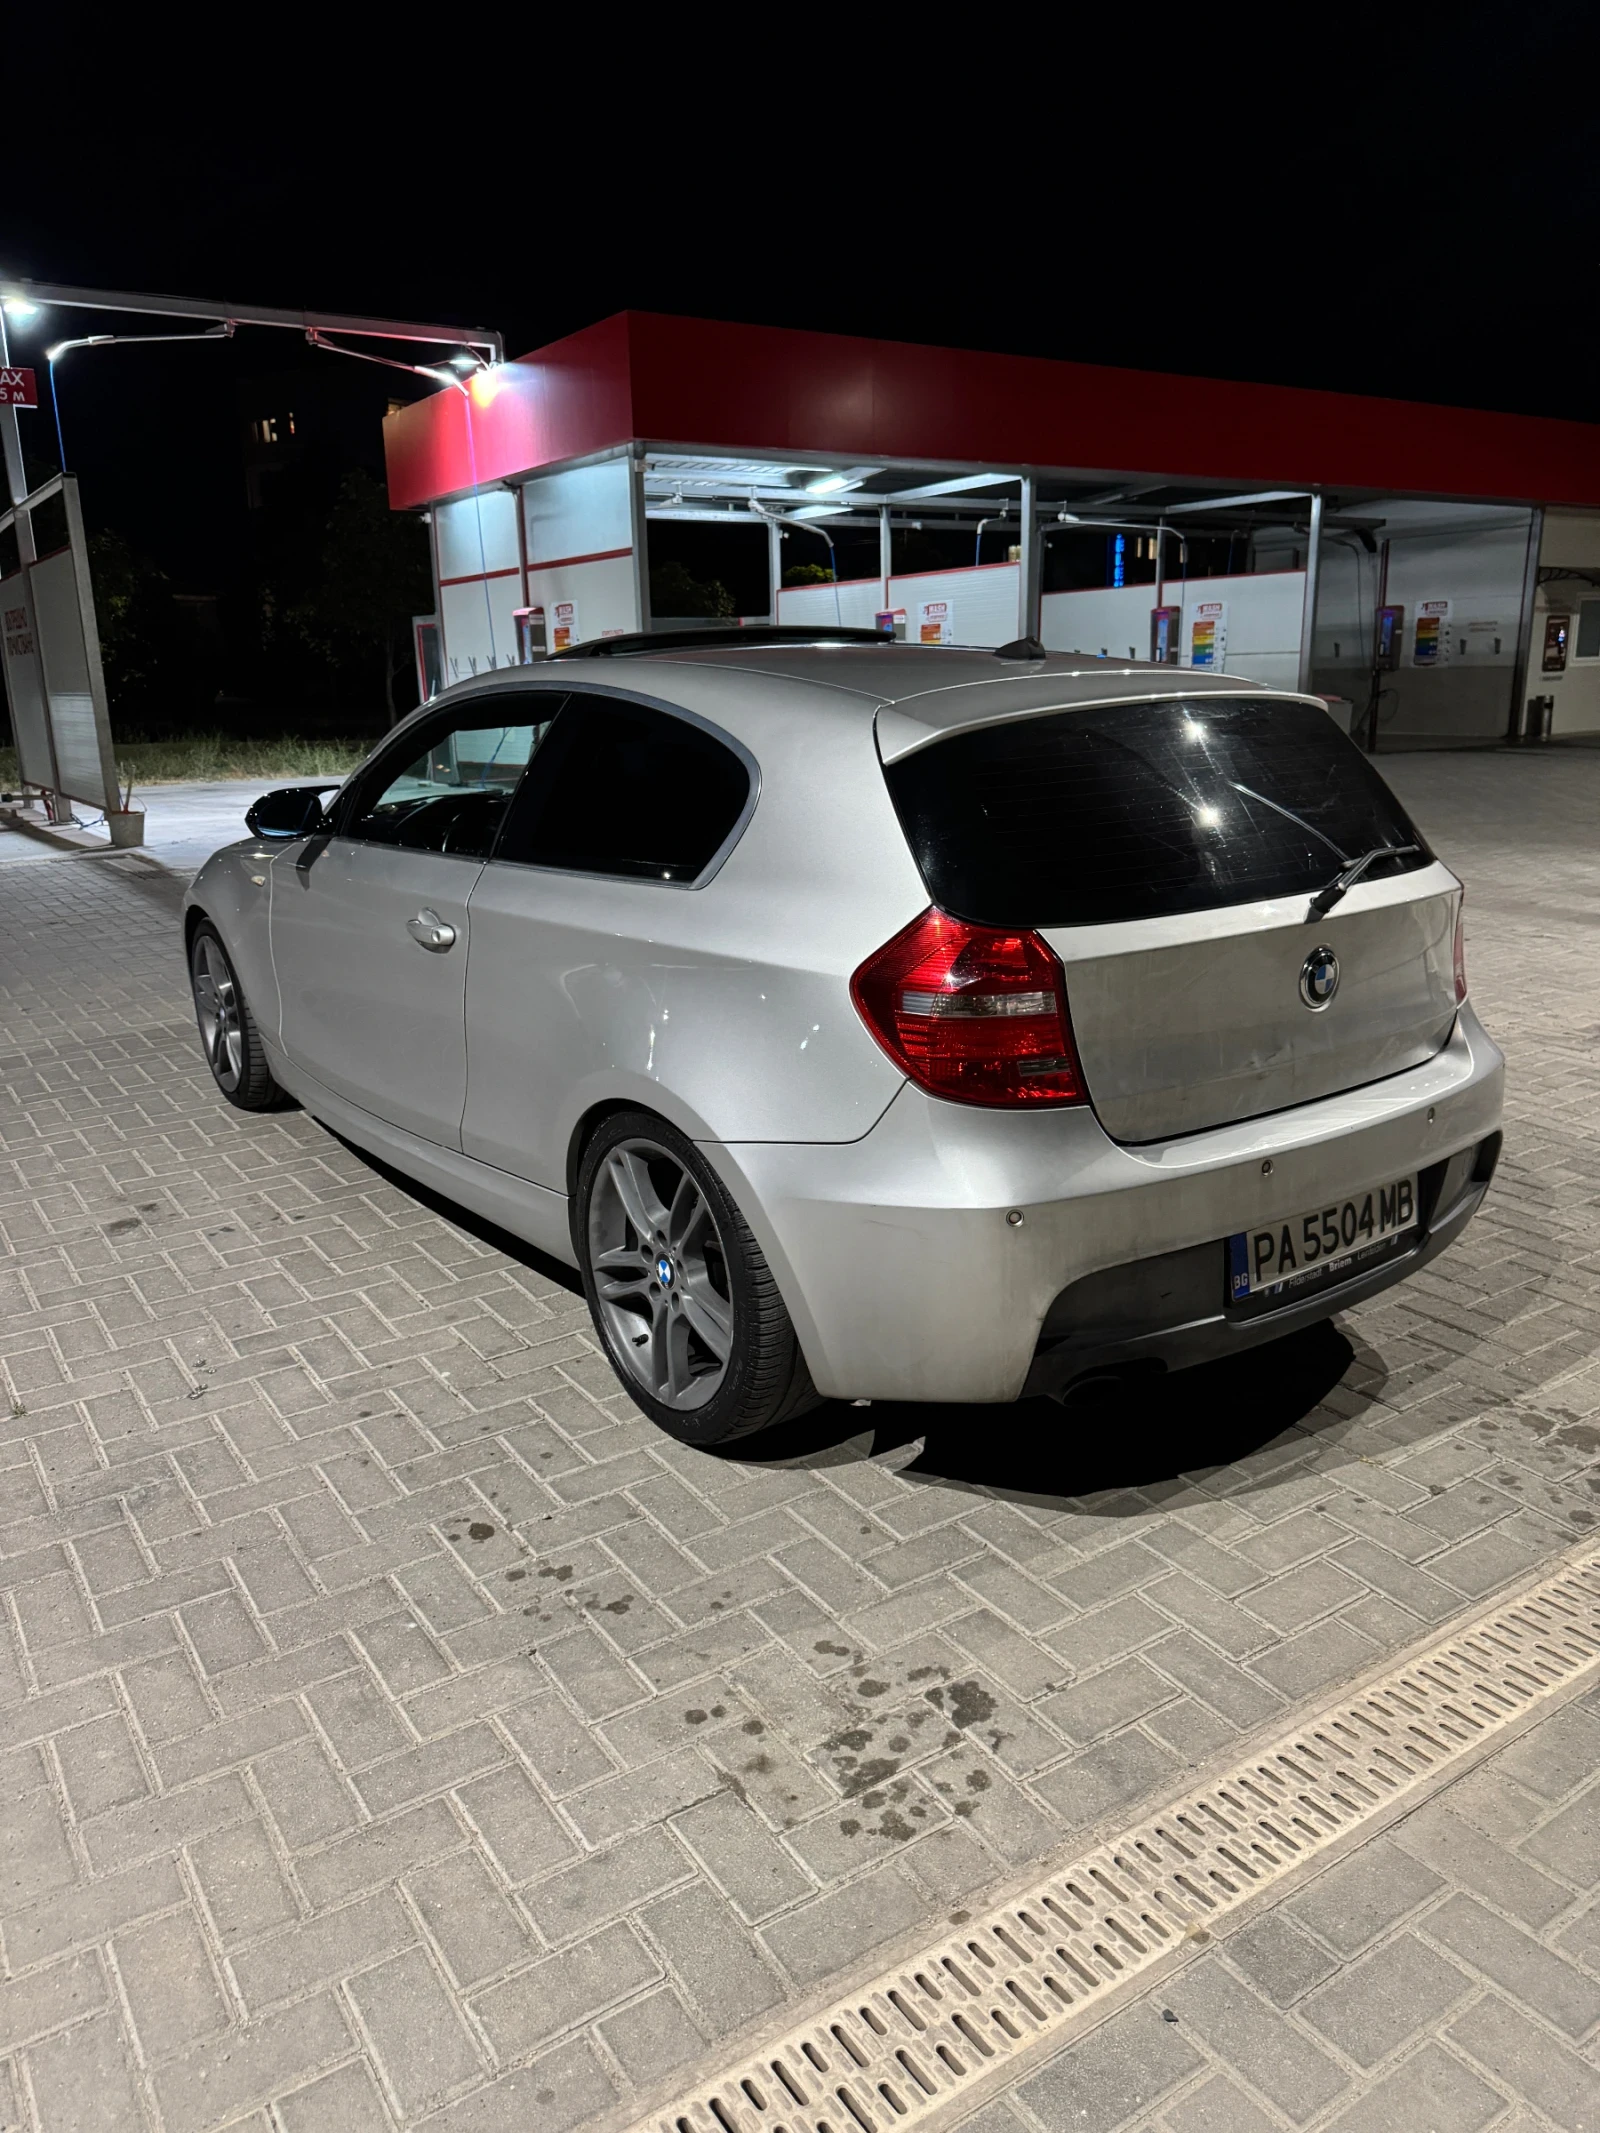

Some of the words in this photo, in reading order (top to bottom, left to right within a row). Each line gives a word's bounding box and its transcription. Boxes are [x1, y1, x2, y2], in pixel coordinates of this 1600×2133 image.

[1303, 1193, 1374, 1262] 5504
[1380, 1179, 1414, 1233] MB
[1328, 1256, 1353, 1273] Briem
[1233, 1272, 1249, 1290] BG
